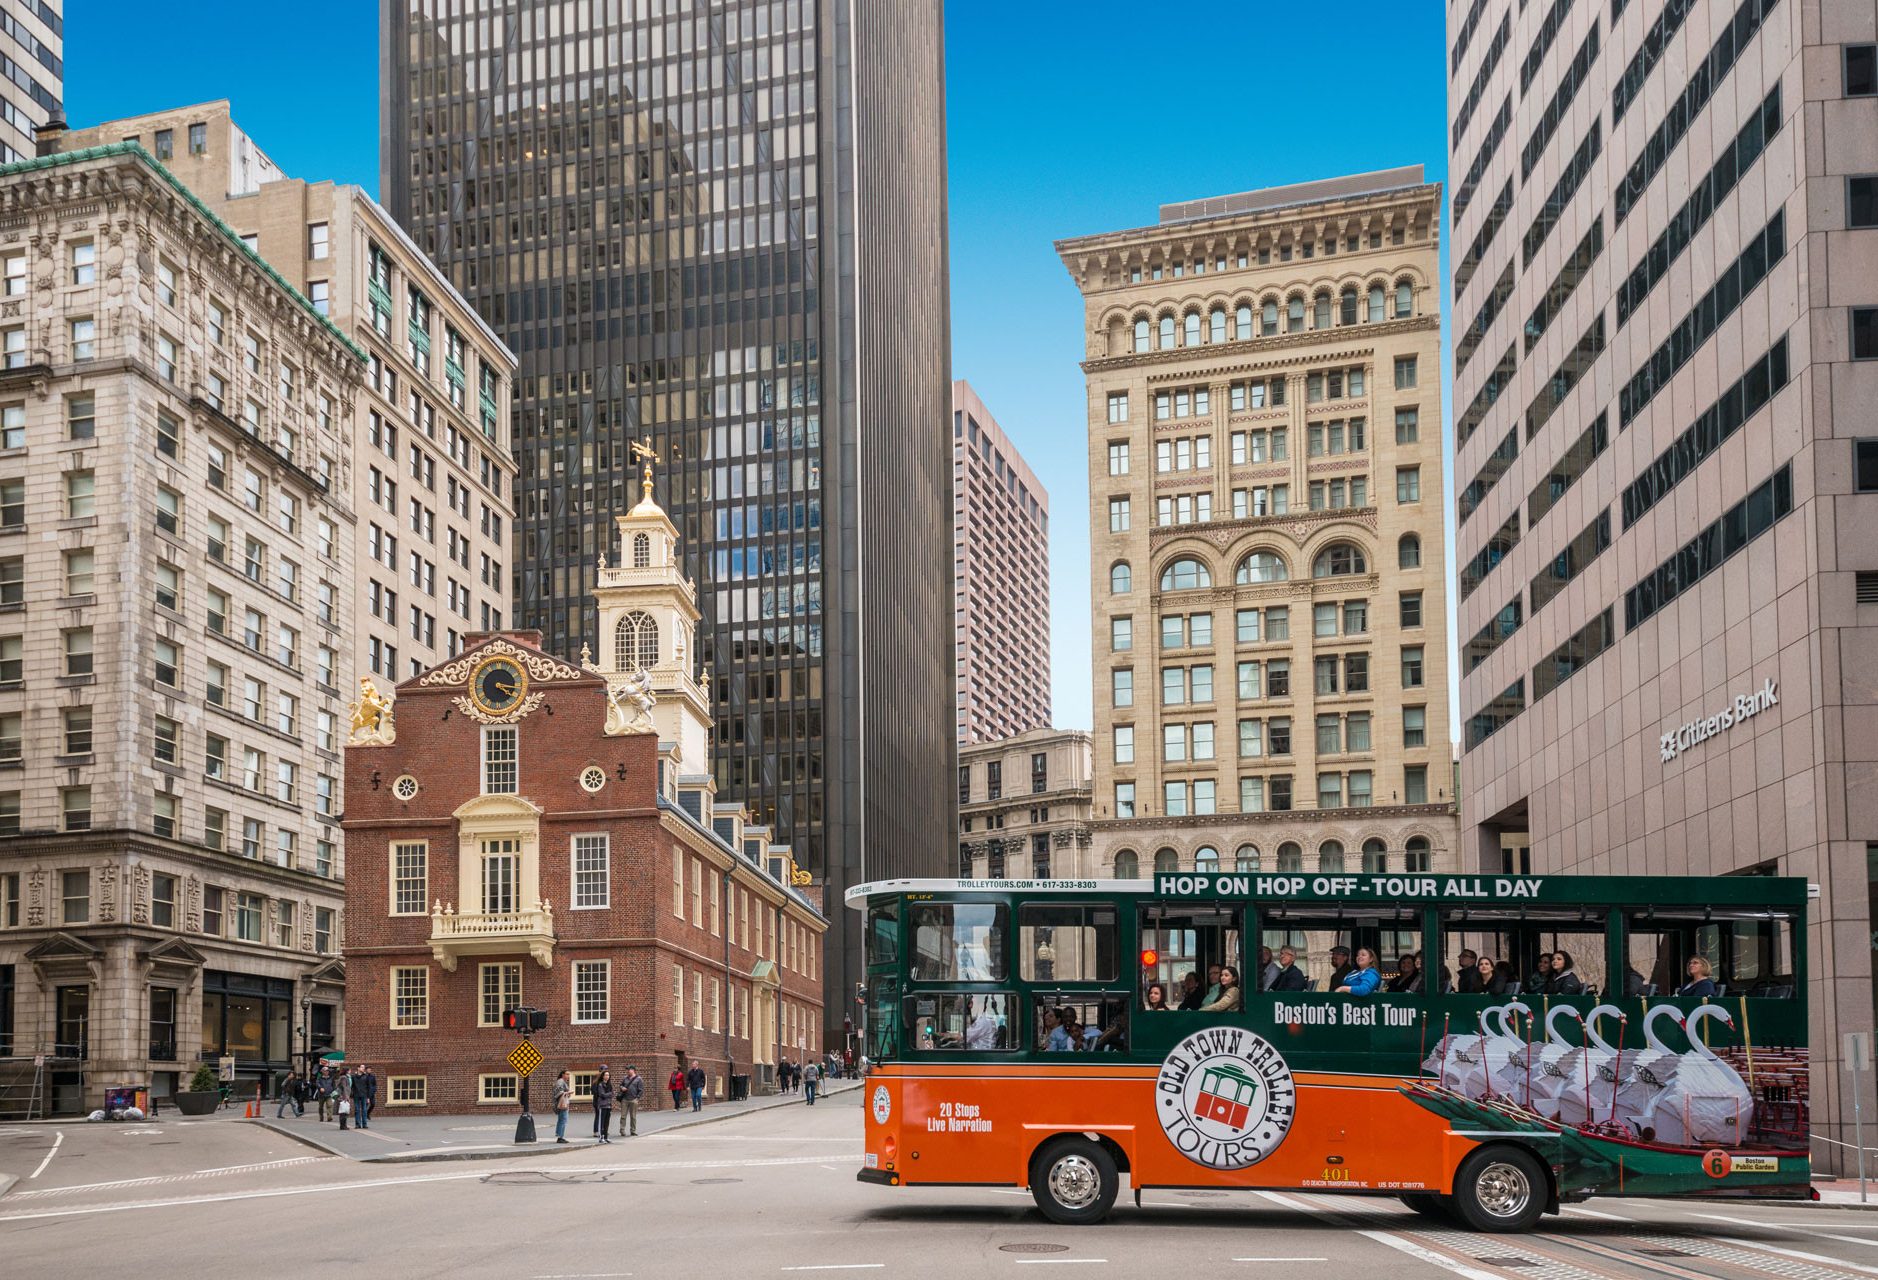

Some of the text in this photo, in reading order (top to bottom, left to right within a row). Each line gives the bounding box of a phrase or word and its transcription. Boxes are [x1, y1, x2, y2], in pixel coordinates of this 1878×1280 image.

[1677, 678, 1778, 751] Citizens Bank
[957, 880, 1097, 889] TROLLEYTOURS.COM 617-333-8303
[1160, 877, 1209, 895] HOP
[1216, 877, 1249, 895] ON
[1256, 877, 1306, 895] HOP
[1443, 878, 1488, 897] ALL
[1495, 879, 1543, 897] DAY
[1274, 1001, 1416, 1026] Boston's Best Tour
[1159, 1029, 1293, 1132] OLD TOWN TROLLEY
[940, 1102, 980, 1119] 20 Stops
[927, 1117, 992, 1133] Live Narration
[1165, 1108, 1261, 1167] TOURS
[1321, 1167, 1350, 1181] 401
[1711, 1157, 1723, 1175] 6
